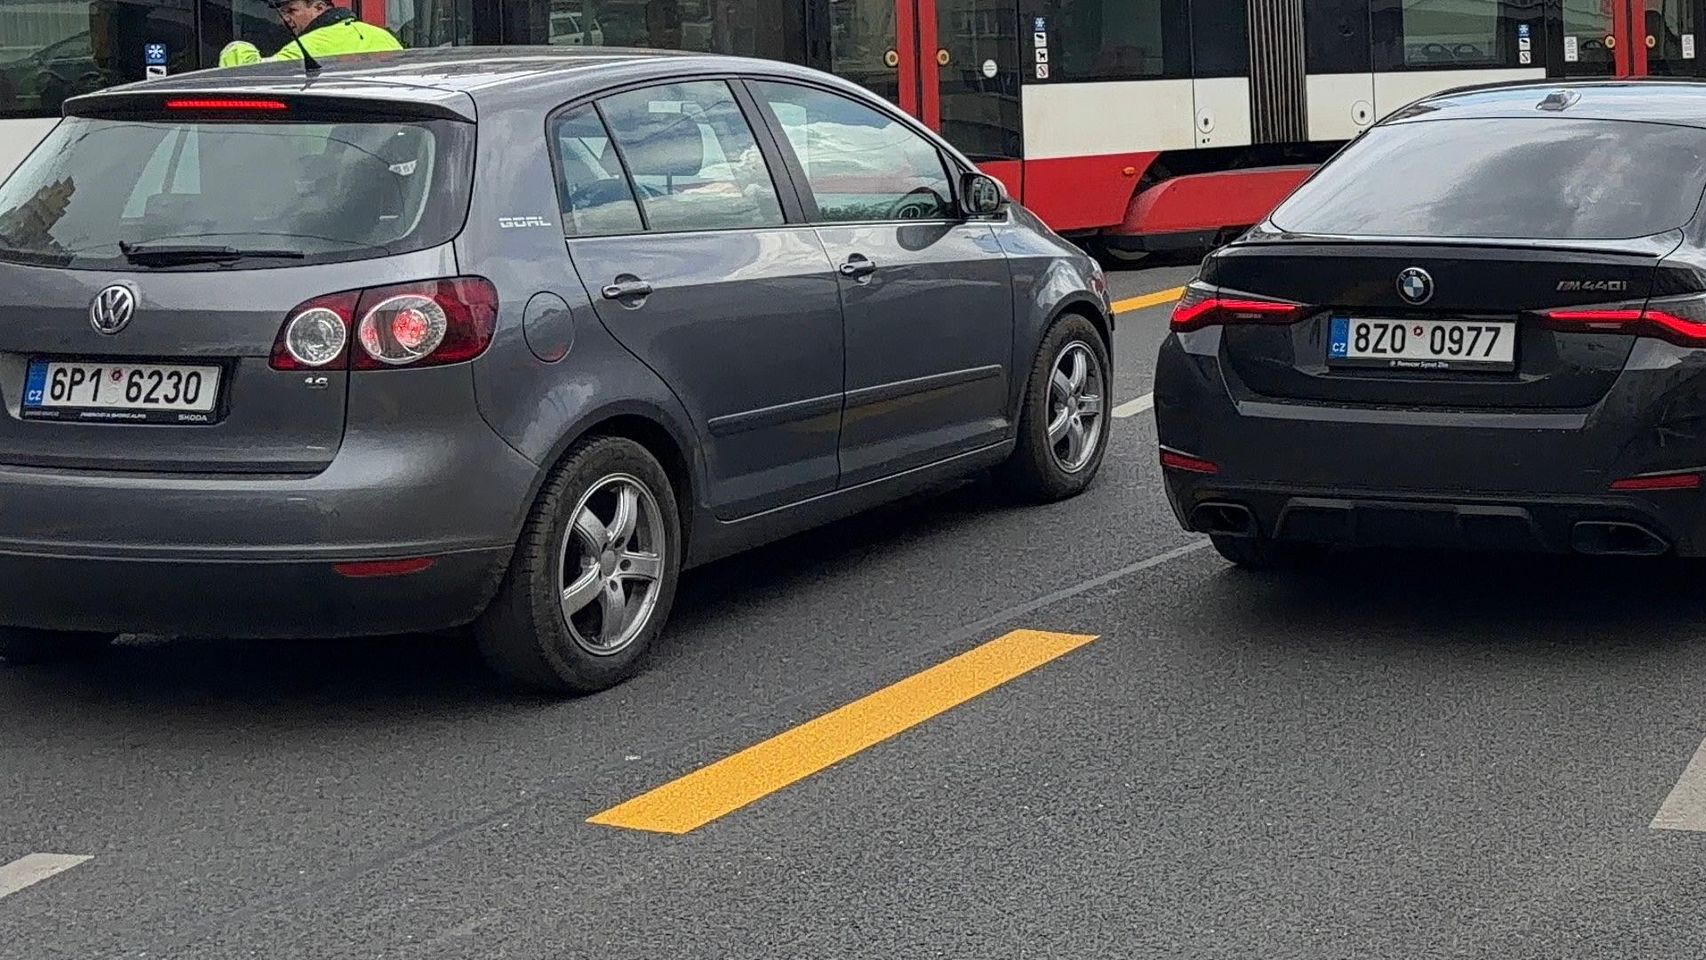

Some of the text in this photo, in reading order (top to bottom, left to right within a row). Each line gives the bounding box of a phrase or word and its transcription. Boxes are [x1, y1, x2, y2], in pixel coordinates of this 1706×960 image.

[1332, 343, 1346, 352] CZ
[1429, 325, 1501, 358] 0977
[28, 391, 42, 402] CZ
[50, 367, 202, 405] 6P1 6230
